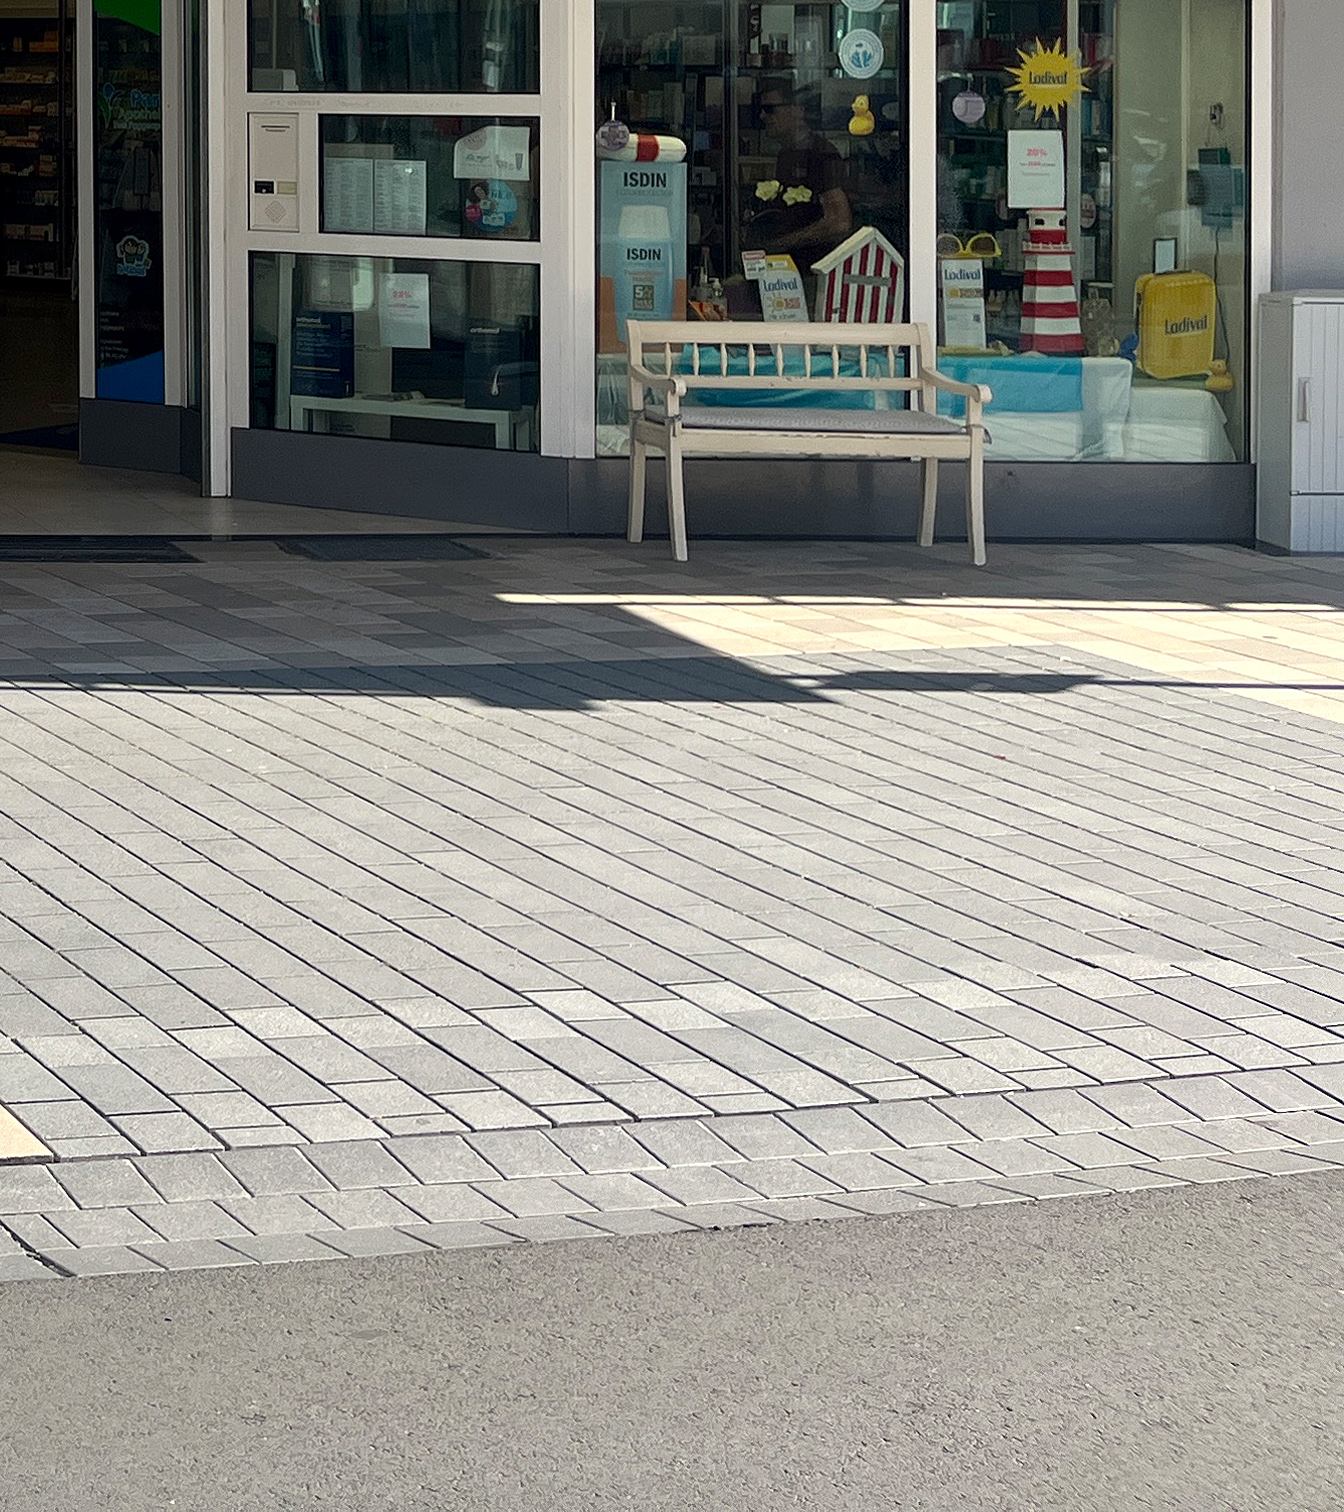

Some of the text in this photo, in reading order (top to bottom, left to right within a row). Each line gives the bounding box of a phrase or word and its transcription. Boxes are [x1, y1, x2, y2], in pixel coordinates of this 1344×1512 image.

[1029, 71, 1067, 84] Ladival
[131, 88, 161, 108] Par
[624, 172, 667, 187] ISDIN
[627, 248, 661, 260] ISDIN
[945, 269, 981, 280] Ladival
[763, 278, 798, 291] Ladival
[1165, 315, 1207, 335] Ladival
